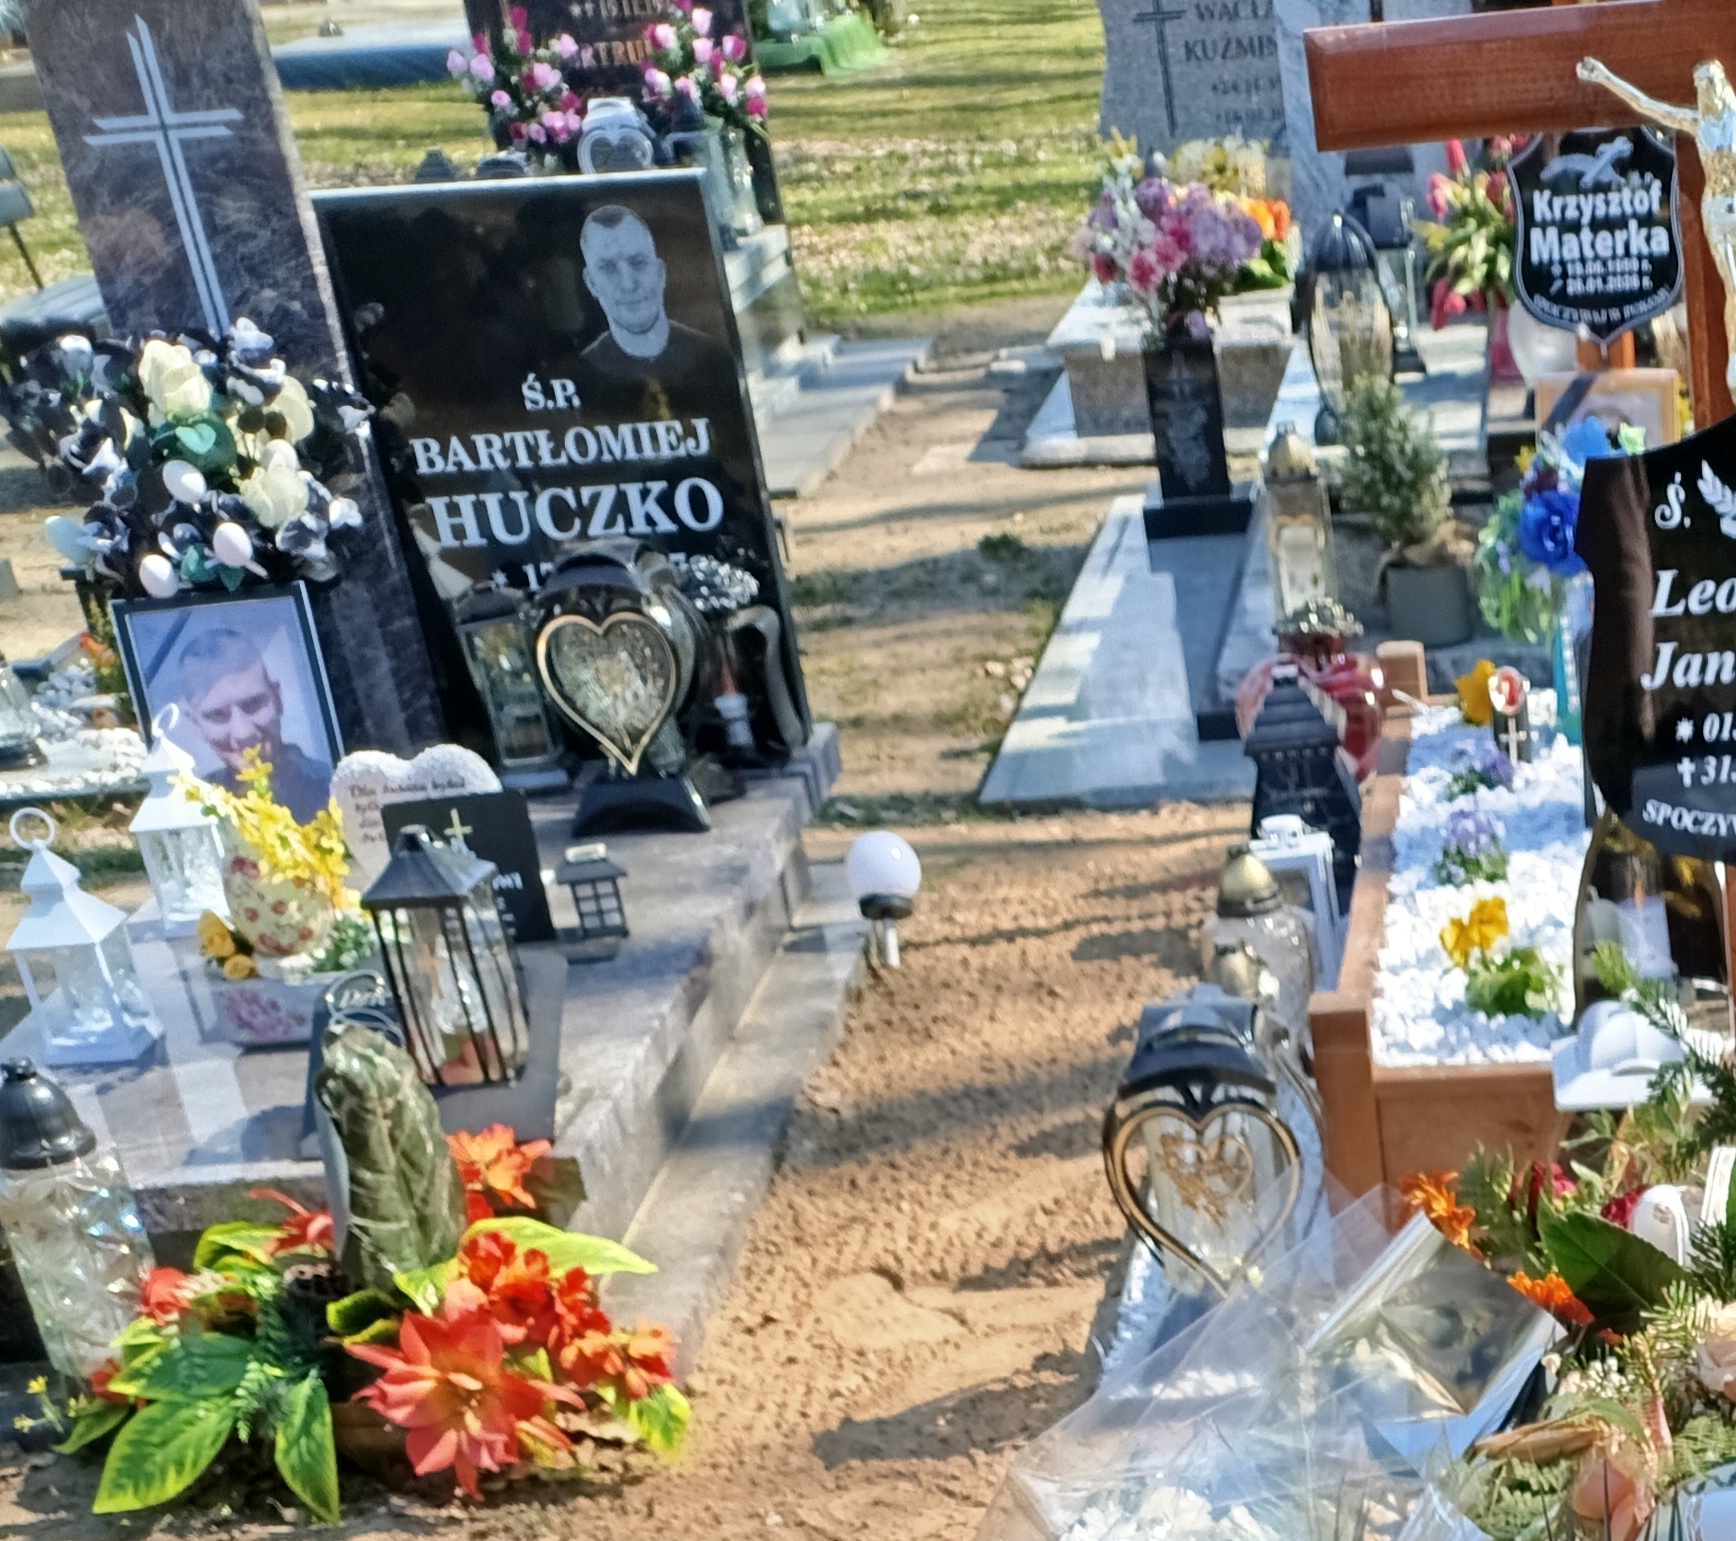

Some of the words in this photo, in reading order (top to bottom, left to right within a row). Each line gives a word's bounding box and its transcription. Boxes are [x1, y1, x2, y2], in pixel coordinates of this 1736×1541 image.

[1532, 178, 1662, 227] Krzysztof
[1529, 218, 1670, 266] Materka
[408, 417, 711, 476] BARTŁOMIEJ
[425, 476, 725, 548] HUCZKO
